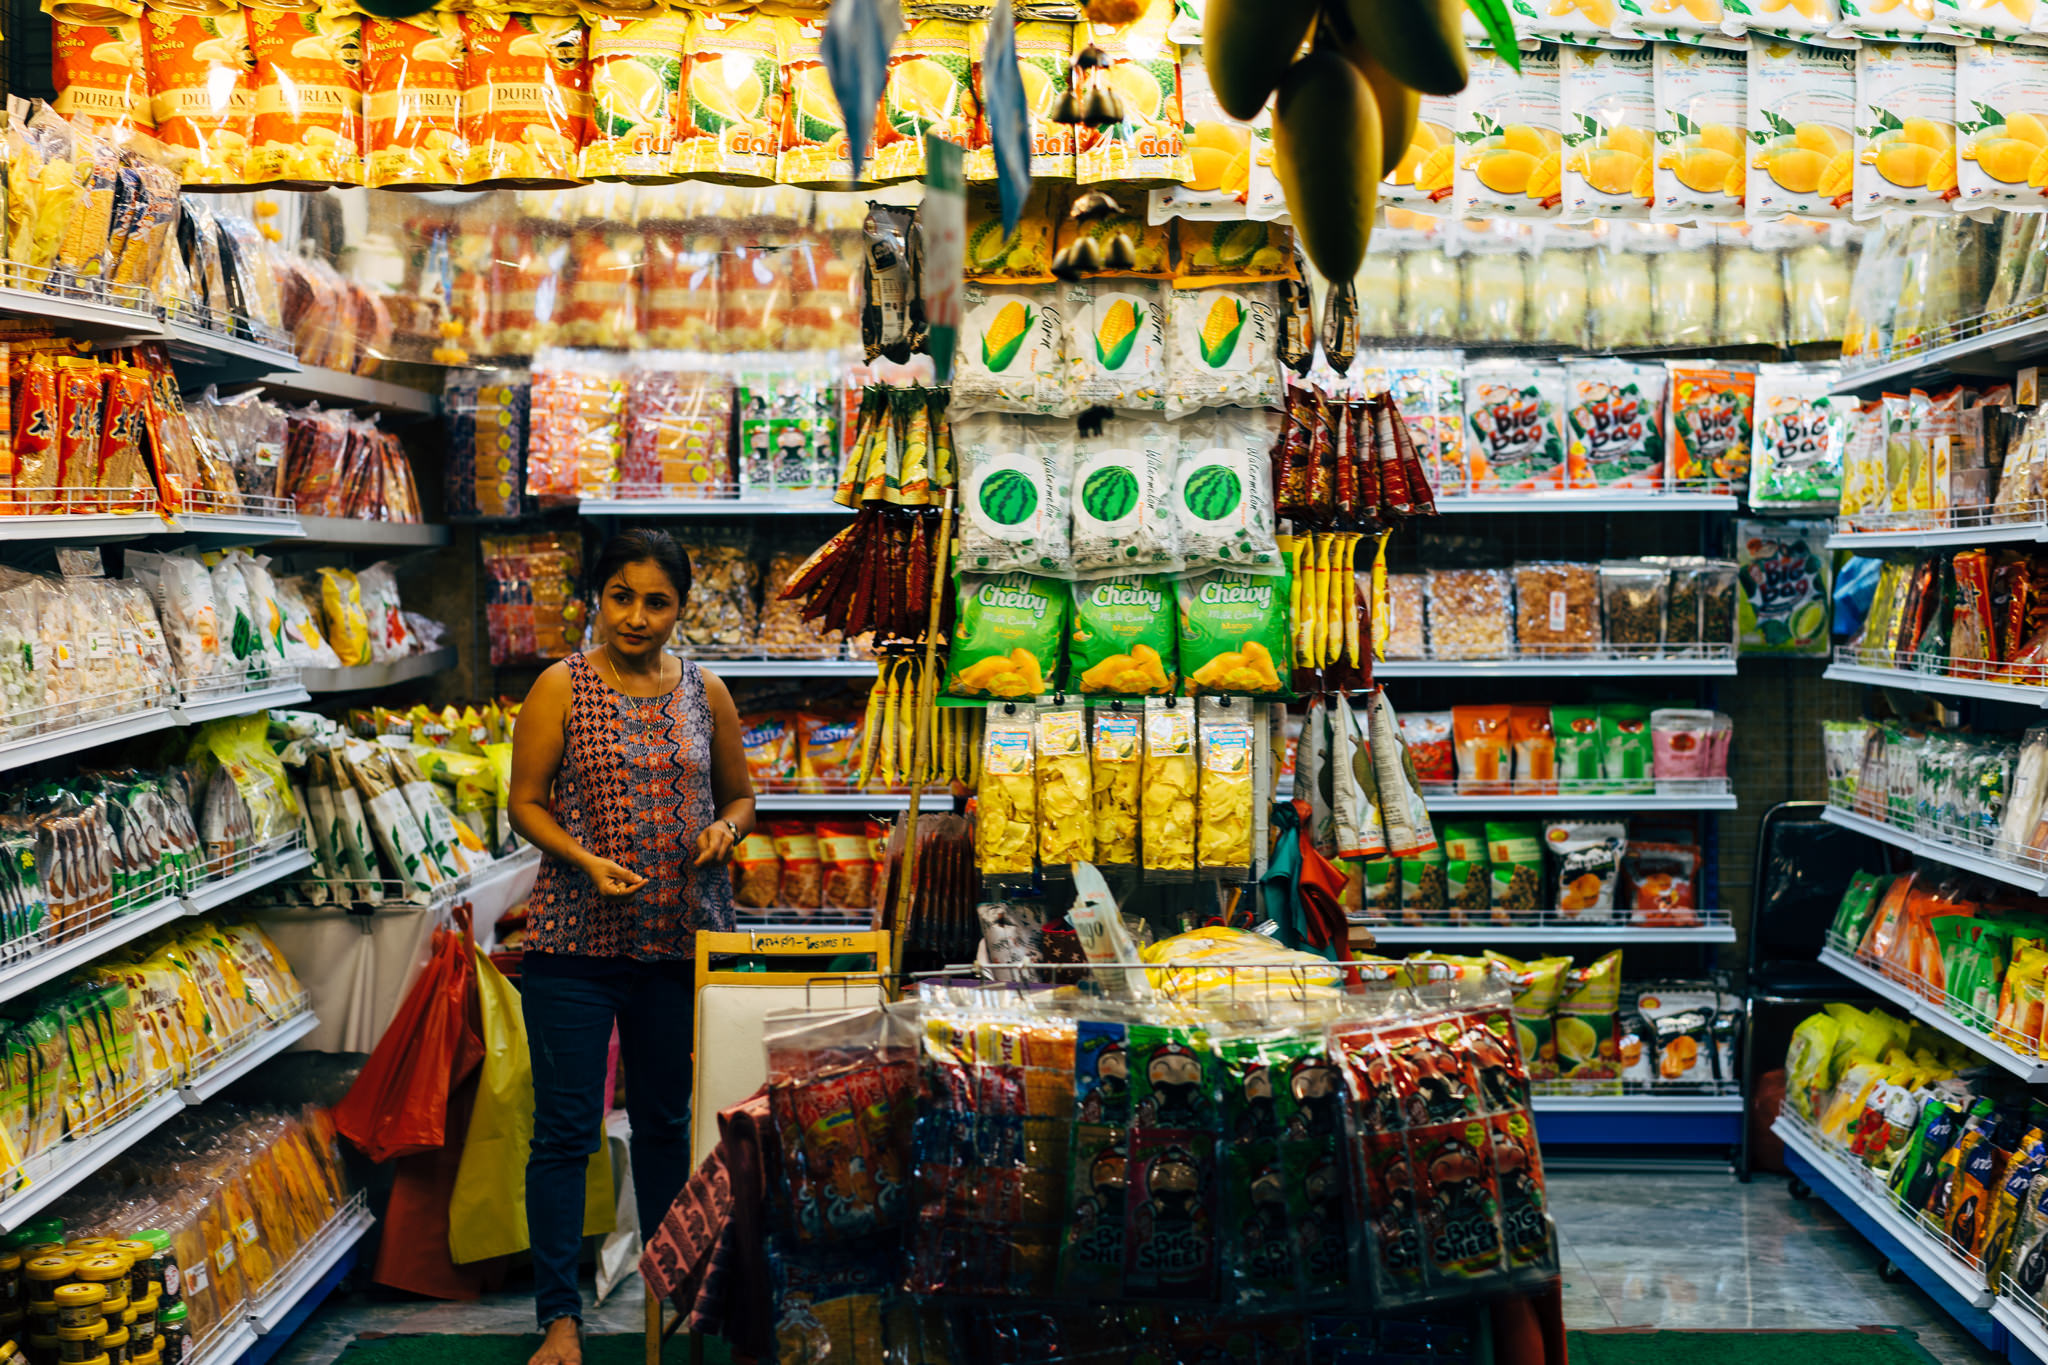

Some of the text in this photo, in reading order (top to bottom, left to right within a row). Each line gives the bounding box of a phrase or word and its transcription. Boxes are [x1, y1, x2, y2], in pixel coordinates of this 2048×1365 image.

[73, 90, 135, 109] DURIAN
[182, 93, 246, 106] DUAN
[279, 89, 342, 103] DRIAN
[496, 87, 554, 100] DURI
[1250, 300, 1273, 342] Corn
[979, 583, 1048, 618] Chewy
[1092, 584, 1162, 612] Chewy
[1200, 582, 1272, 609] Chewy
[1446, 1216, 1486, 1244] BIG
